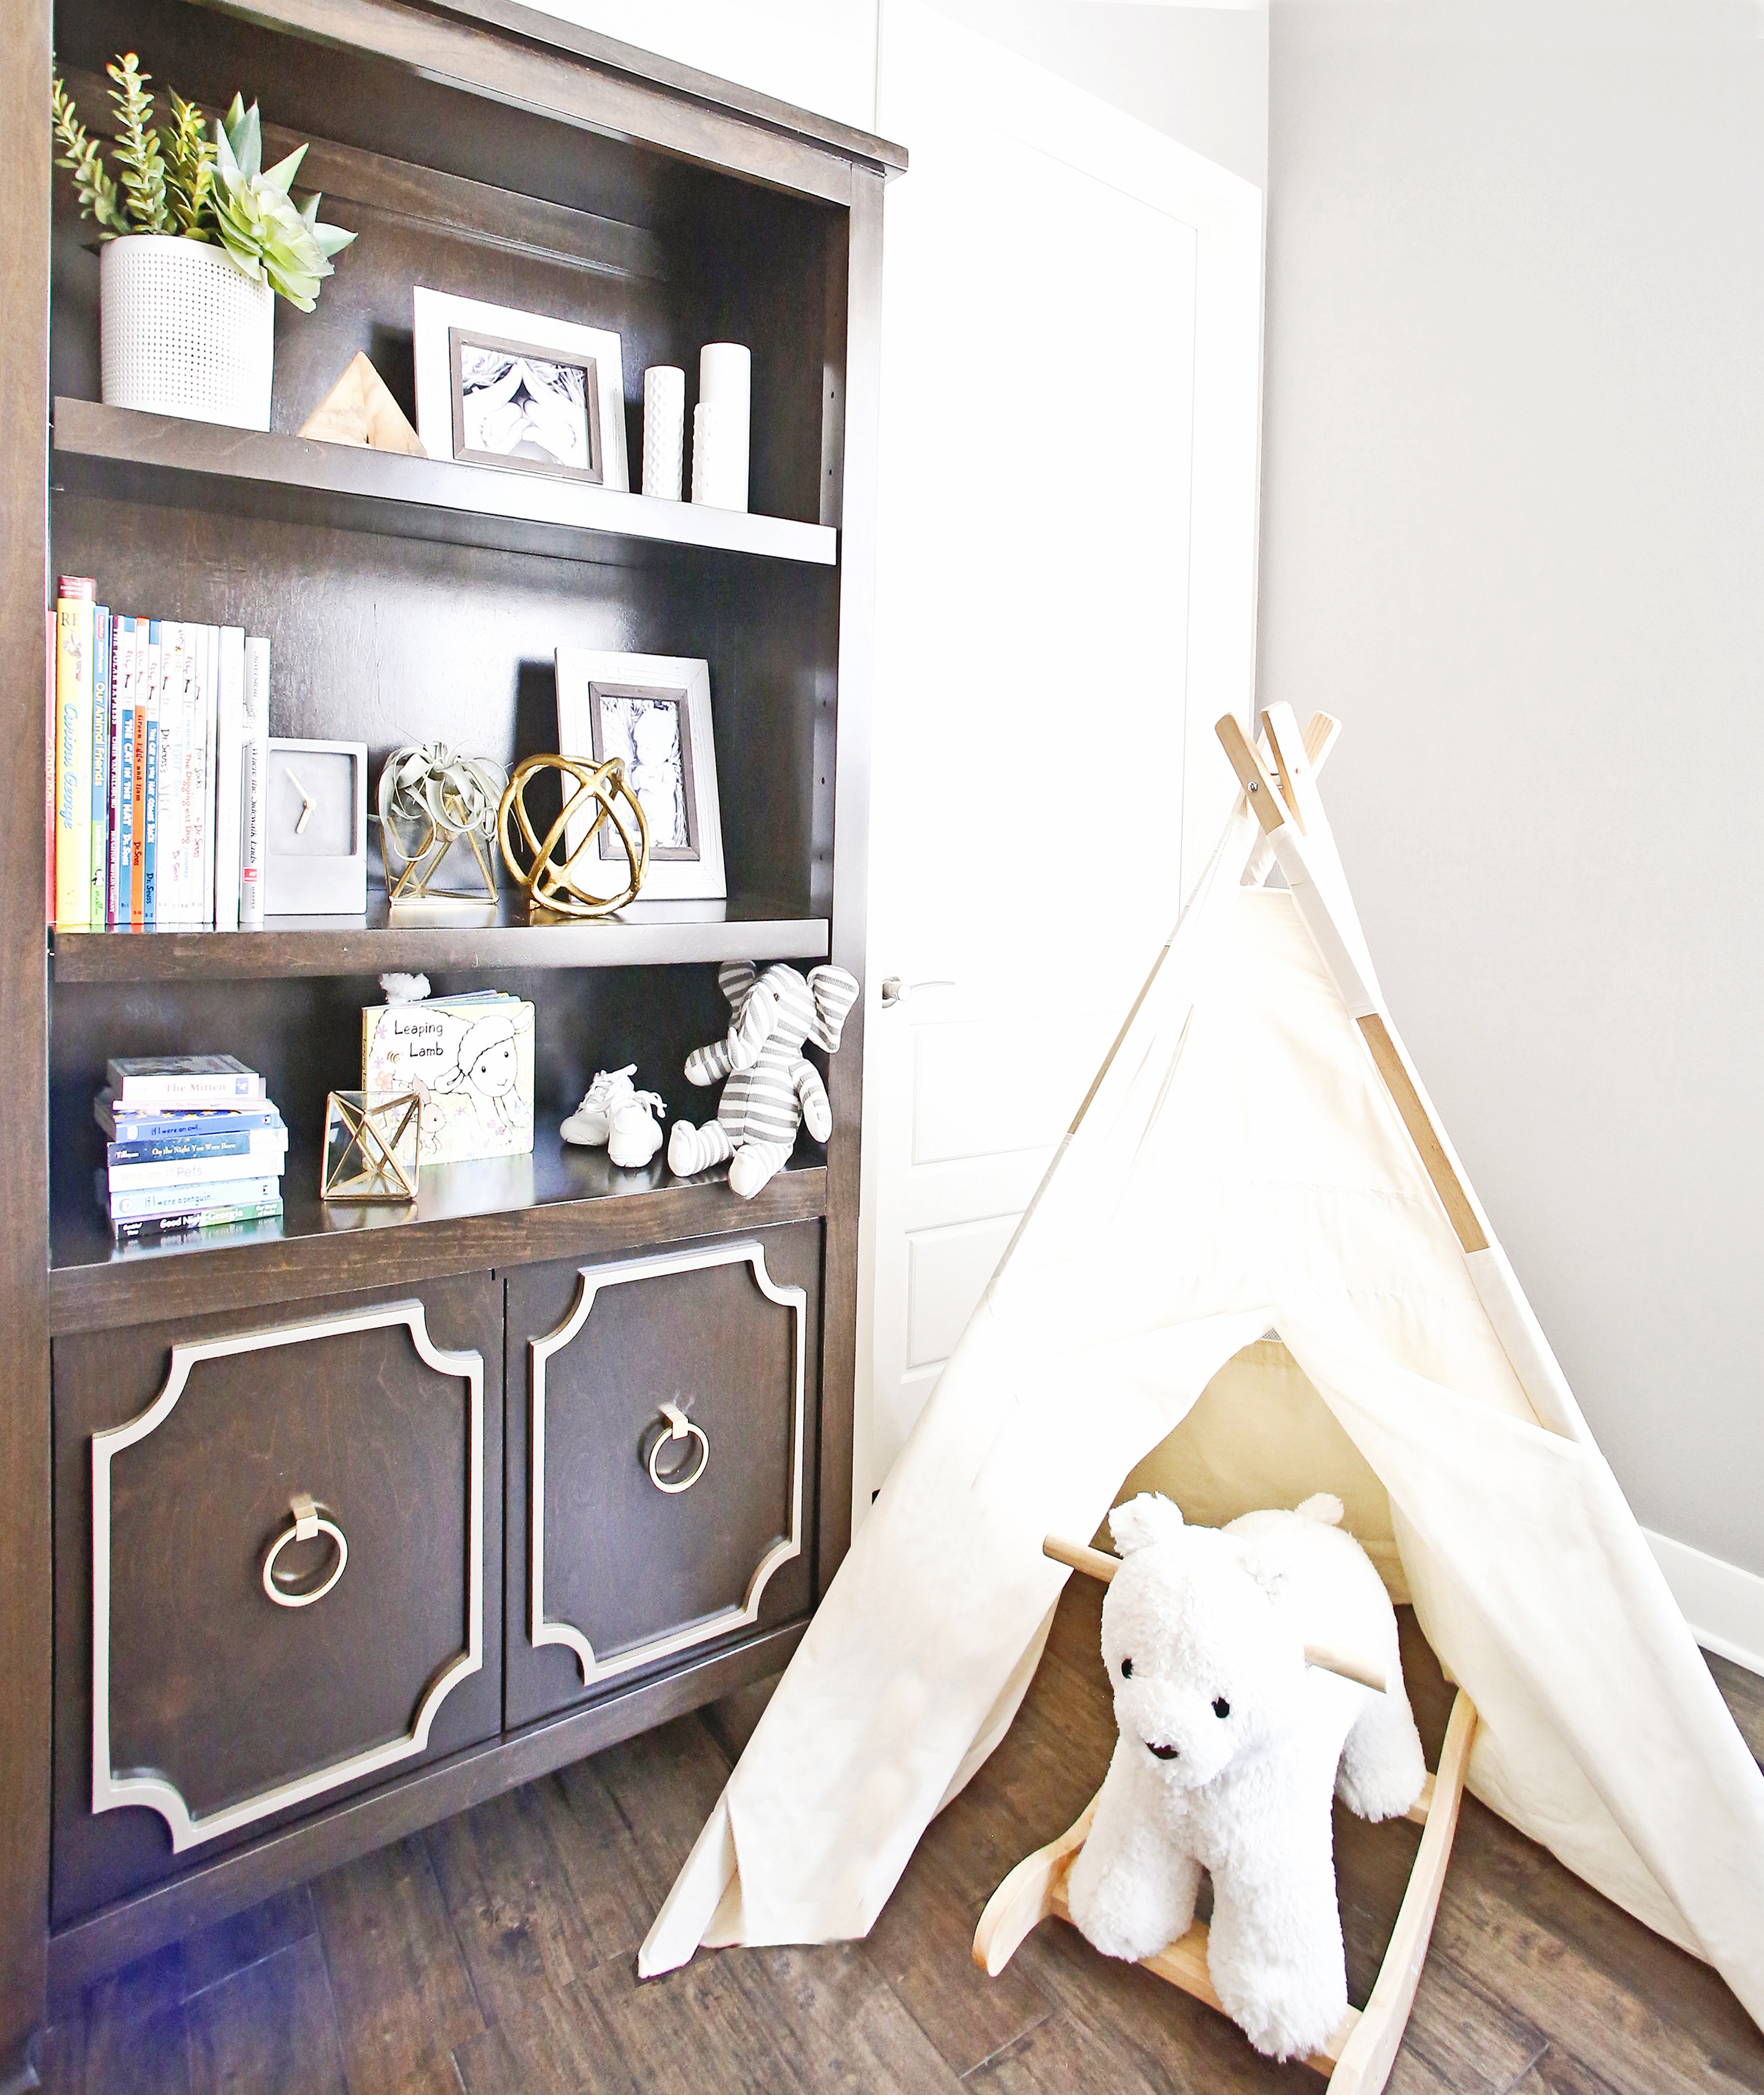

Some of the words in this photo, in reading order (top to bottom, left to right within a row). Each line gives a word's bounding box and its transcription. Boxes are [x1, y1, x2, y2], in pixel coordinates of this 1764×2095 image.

[95, 681, 105, 704] Our
[95, 704, 105, 745] Animal
[124, 719, 133, 740] THE
[63, 702, 79, 767] Curious
[159, 728, 170, 742] Dr.
[123, 742, 133, 764] CAT
[135, 742, 143, 762] Eggs
[148, 742, 156, 756] CAT
[194, 748, 204, 761] Fox
[94, 747, 105, 787] Friends
[147, 756, 155, 764] IN
[159, 744, 170, 774] Seuss's
[123, 766, 132, 779] IN
[147, 766, 156, 780] THE
[193, 767, 204, 789] Socks
[123, 781, 131, 800] THE
[147, 781, 156, 796] HAT
[59, 771, 77, 829] George
[146, 797, 155, 822] COMES
[122, 802, 132, 827] HAT
[249, 796, 258, 838] Sidewalk
[122, 833, 131, 846] Dr.
[146, 823, 155, 844] BACK
[181, 825, 192, 844] Dog
[193, 824, 202, 837] Dr.
[133, 841, 141, 851] Dr.
[192, 838, 203, 858] Seuss
[249, 840, 258, 864] Ends
[121, 846, 131, 866] Seuss
[133, 851, 141, 866] Seuss
[145, 872, 153, 884] Dr.
[145, 885, 154, 904] Seuss
[395, 1020, 443, 1037] Leaping
[410, 1041, 444, 1057] Lamb
[164, 1083, 186, 1092] The
[190, 1082, 226, 1092] Mitten
[151, 1127, 158, 1136] If
[151, 1148, 163, 1156] On
[162, 1146, 173, 1155] the
[174, 1144, 191, 1155] Night
[204, 1143, 220, 1151] Were
[121, 1172, 143, 1182] Who
[176, 1166, 203, 1178] Pets
[159, 1216, 182, 1229] Good
[208, 1208, 243, 1221] Georgia
